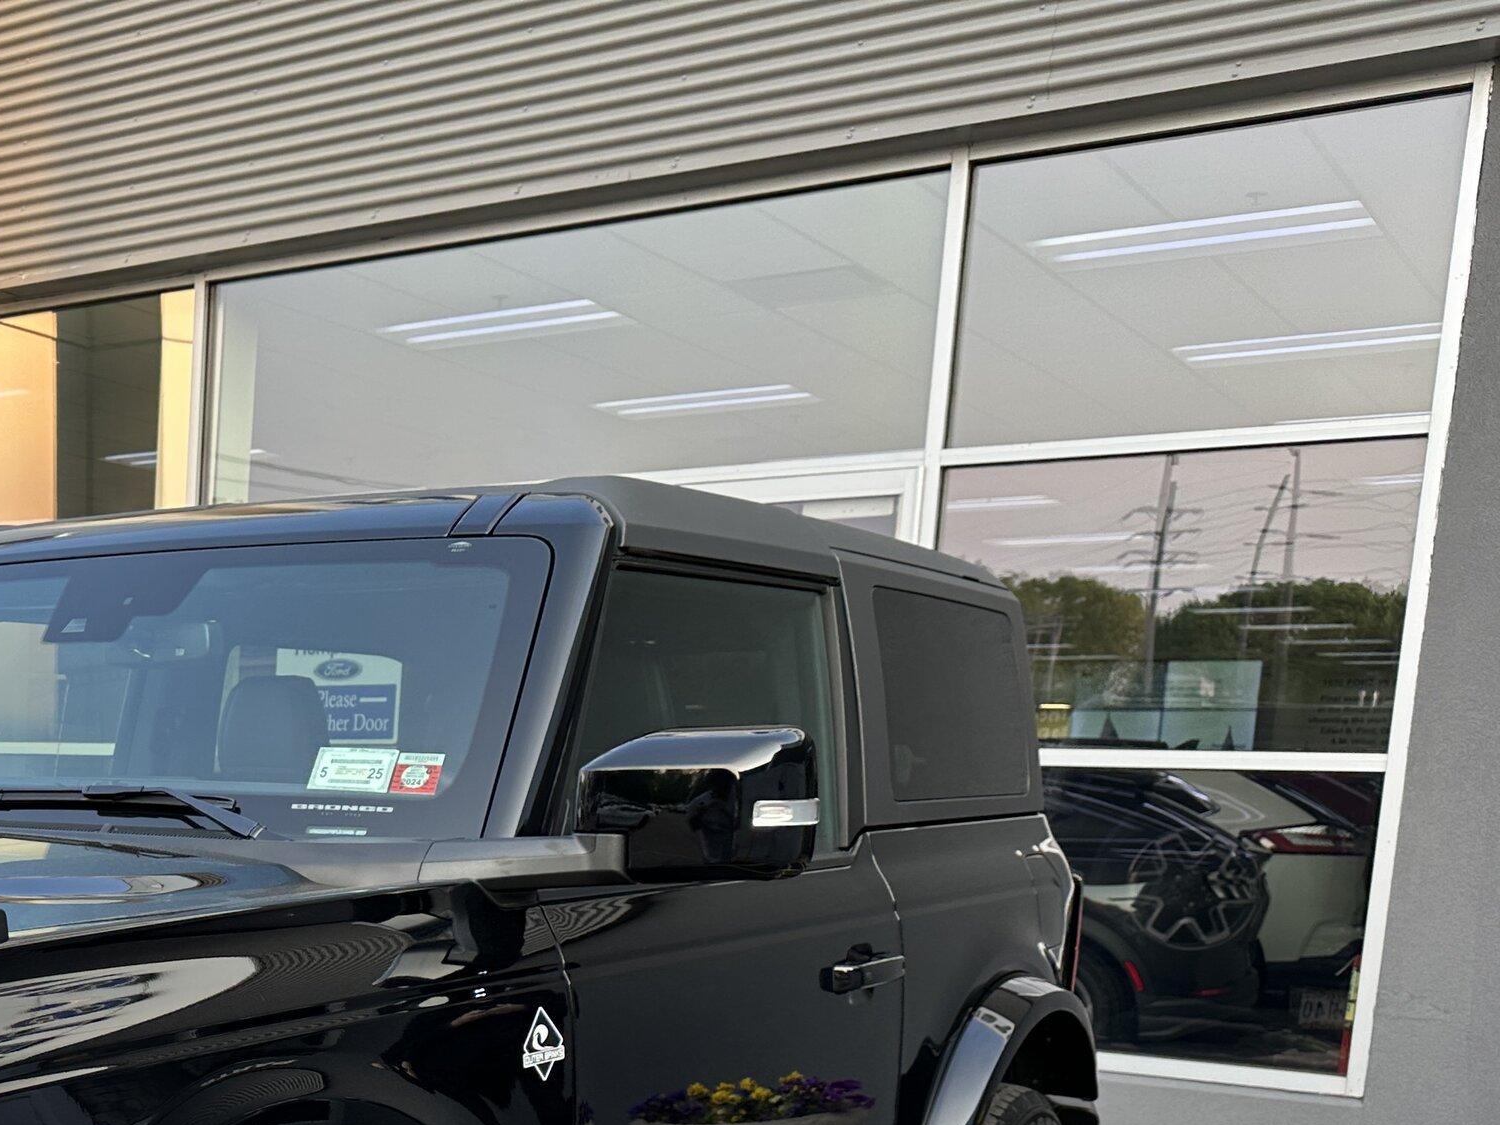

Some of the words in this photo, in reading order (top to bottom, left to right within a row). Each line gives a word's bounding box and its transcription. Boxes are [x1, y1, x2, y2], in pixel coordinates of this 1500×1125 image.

[327, 714, 350, 731] her
[353, 714, 390, 732] Door
[319, 767, 328, 778] 5
[367, 768, 384, 780] 25
[291, 803, 393, 813] BRONCO
